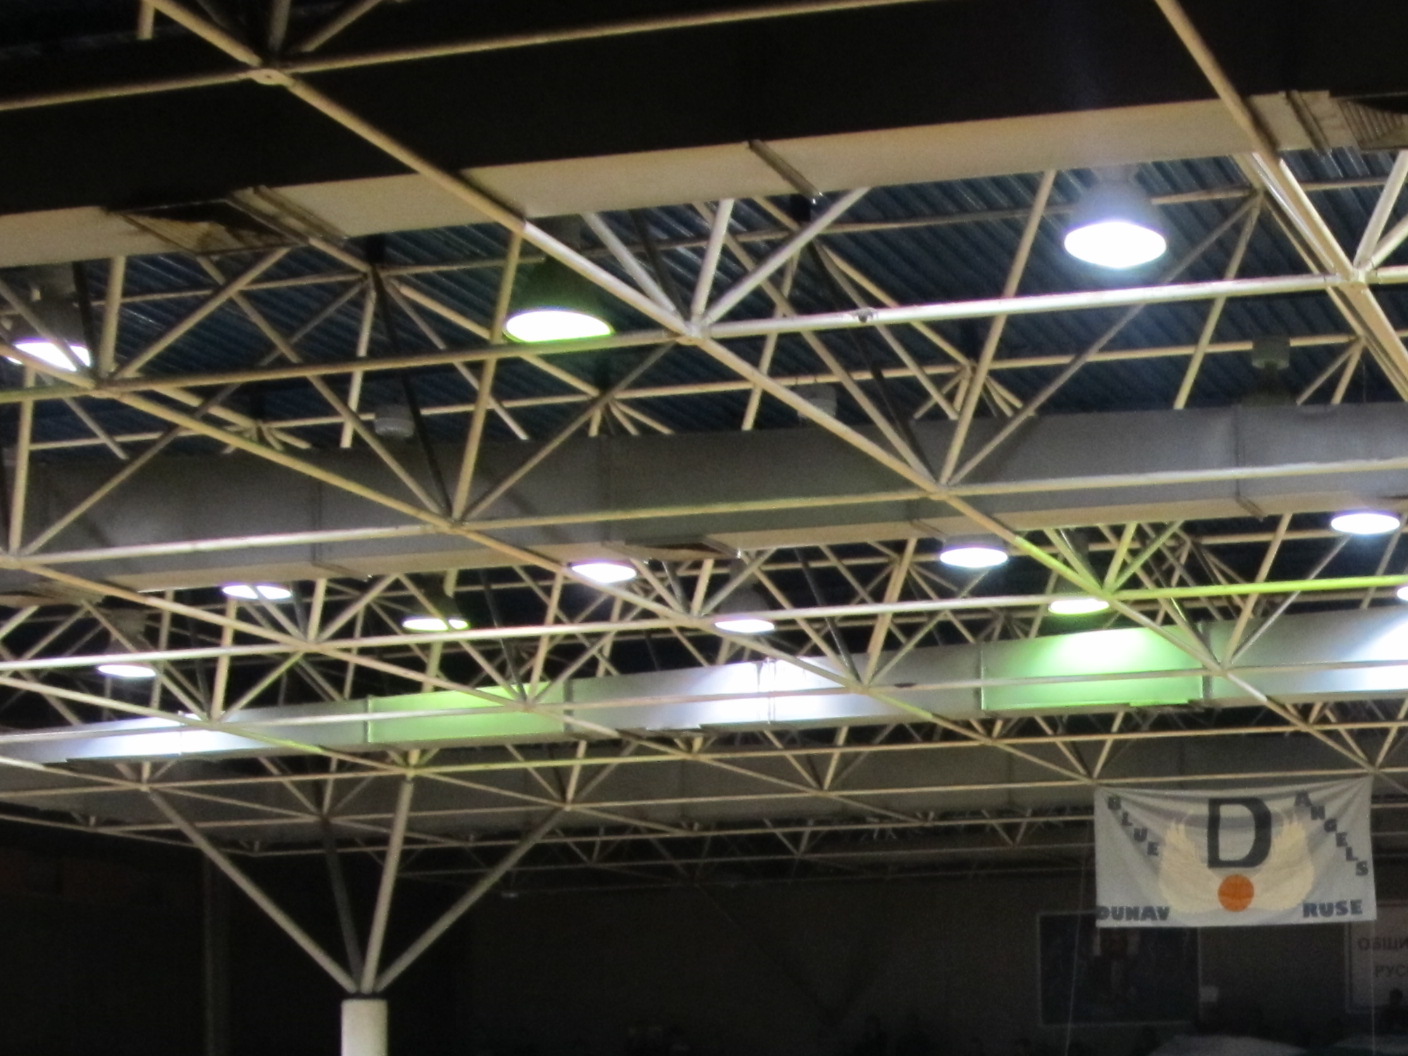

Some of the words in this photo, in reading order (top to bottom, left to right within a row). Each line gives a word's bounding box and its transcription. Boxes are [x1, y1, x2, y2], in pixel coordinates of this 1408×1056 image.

[1107, 796, 1160, 856] BLUE
[1207, 798, 1272, 868] D
[1294, 790, 1369, 877] ANGELS
[1302, 900, 1363, 918] RUSE
